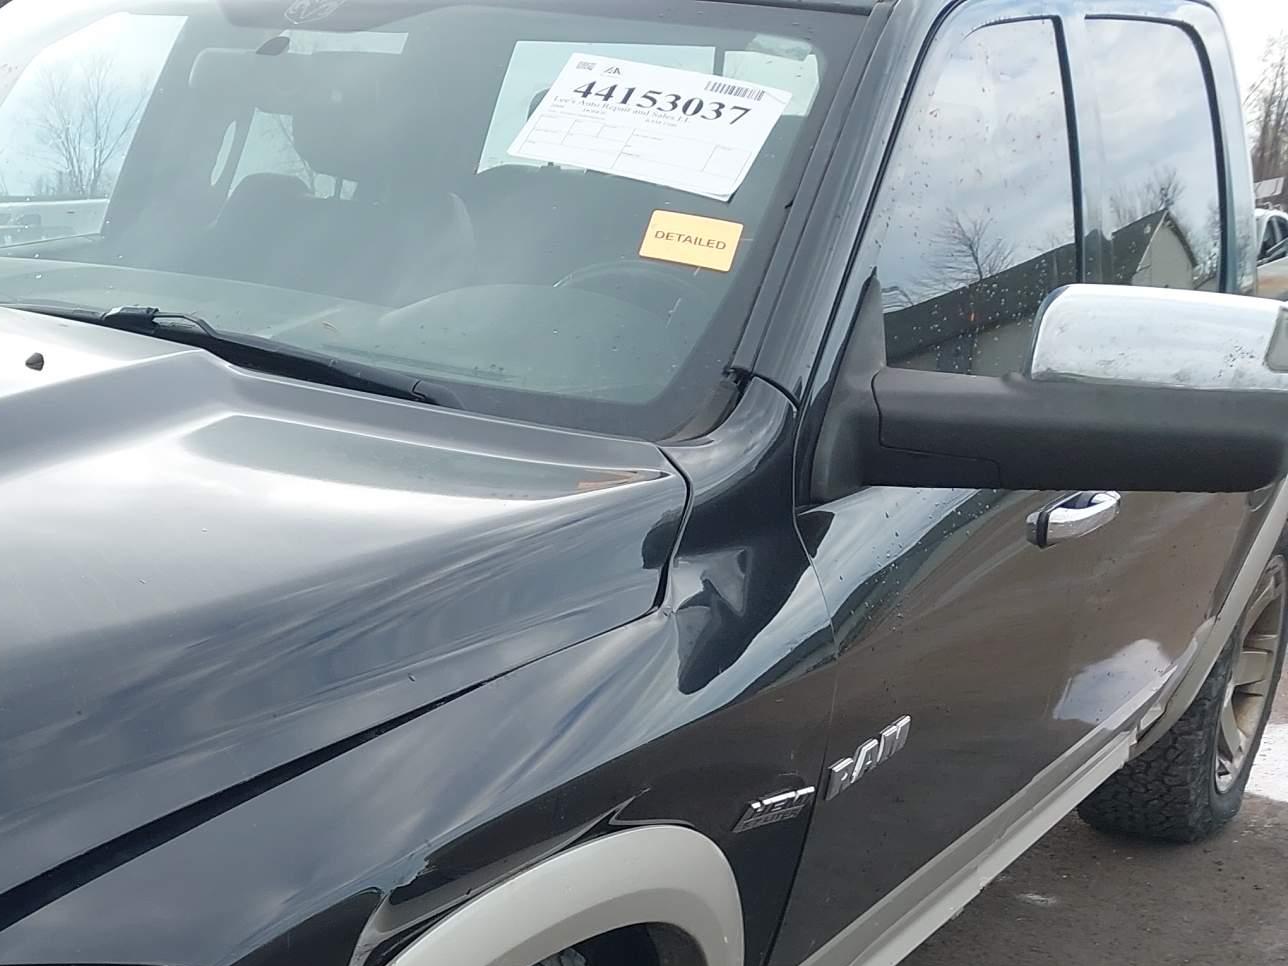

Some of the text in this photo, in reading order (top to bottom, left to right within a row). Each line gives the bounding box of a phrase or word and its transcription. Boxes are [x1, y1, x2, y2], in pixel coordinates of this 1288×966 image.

[573, 80, 751, 125] 44153037
[654, 230, 727, 250] DETAILED
[825, 715, 911, 801] RAM
